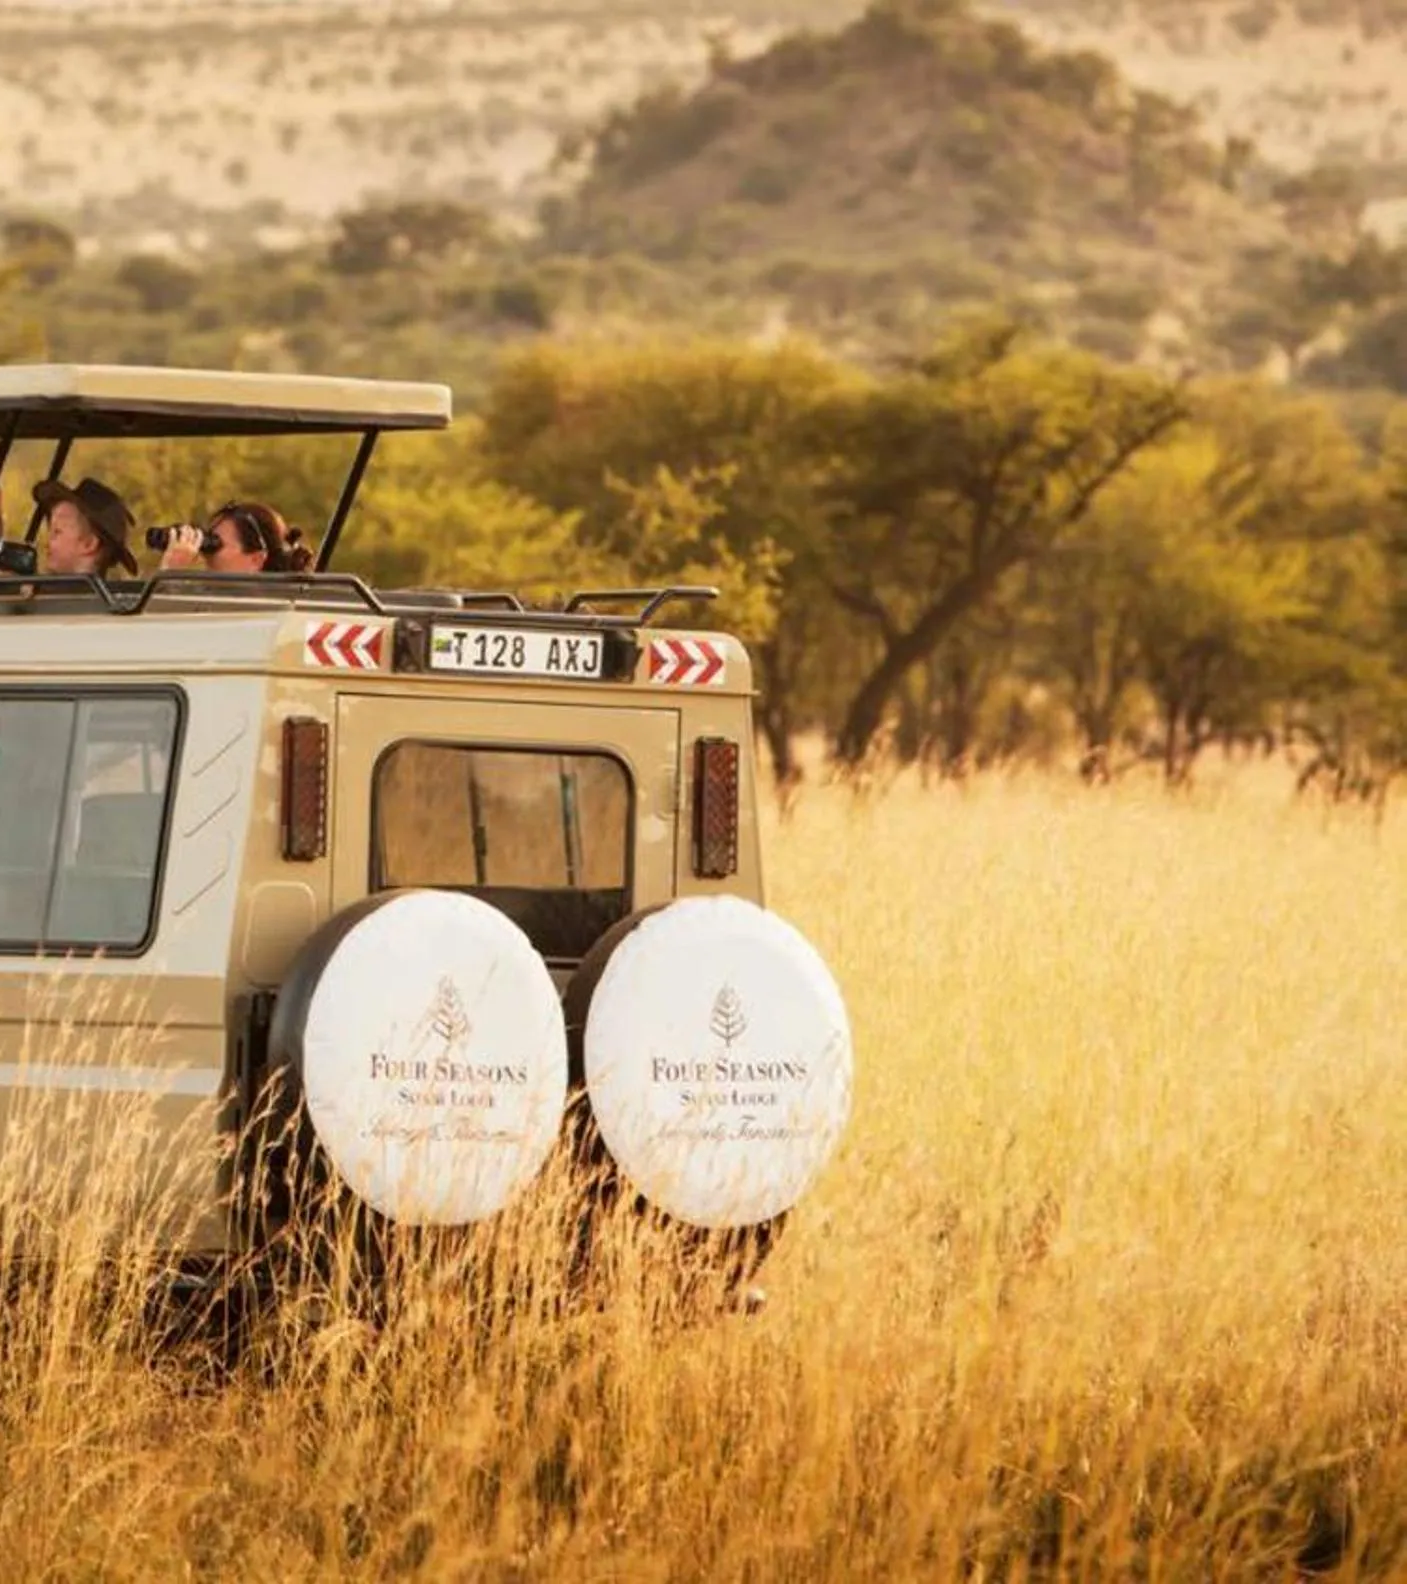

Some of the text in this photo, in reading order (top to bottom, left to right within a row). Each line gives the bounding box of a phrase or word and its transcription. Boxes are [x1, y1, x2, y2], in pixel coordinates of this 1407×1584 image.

[545, 637, 599, 673] AXJ
[369, 1053, 529, 1085] FOUR SEASONS
[714, 1056, 809, 1083] SEASONS
